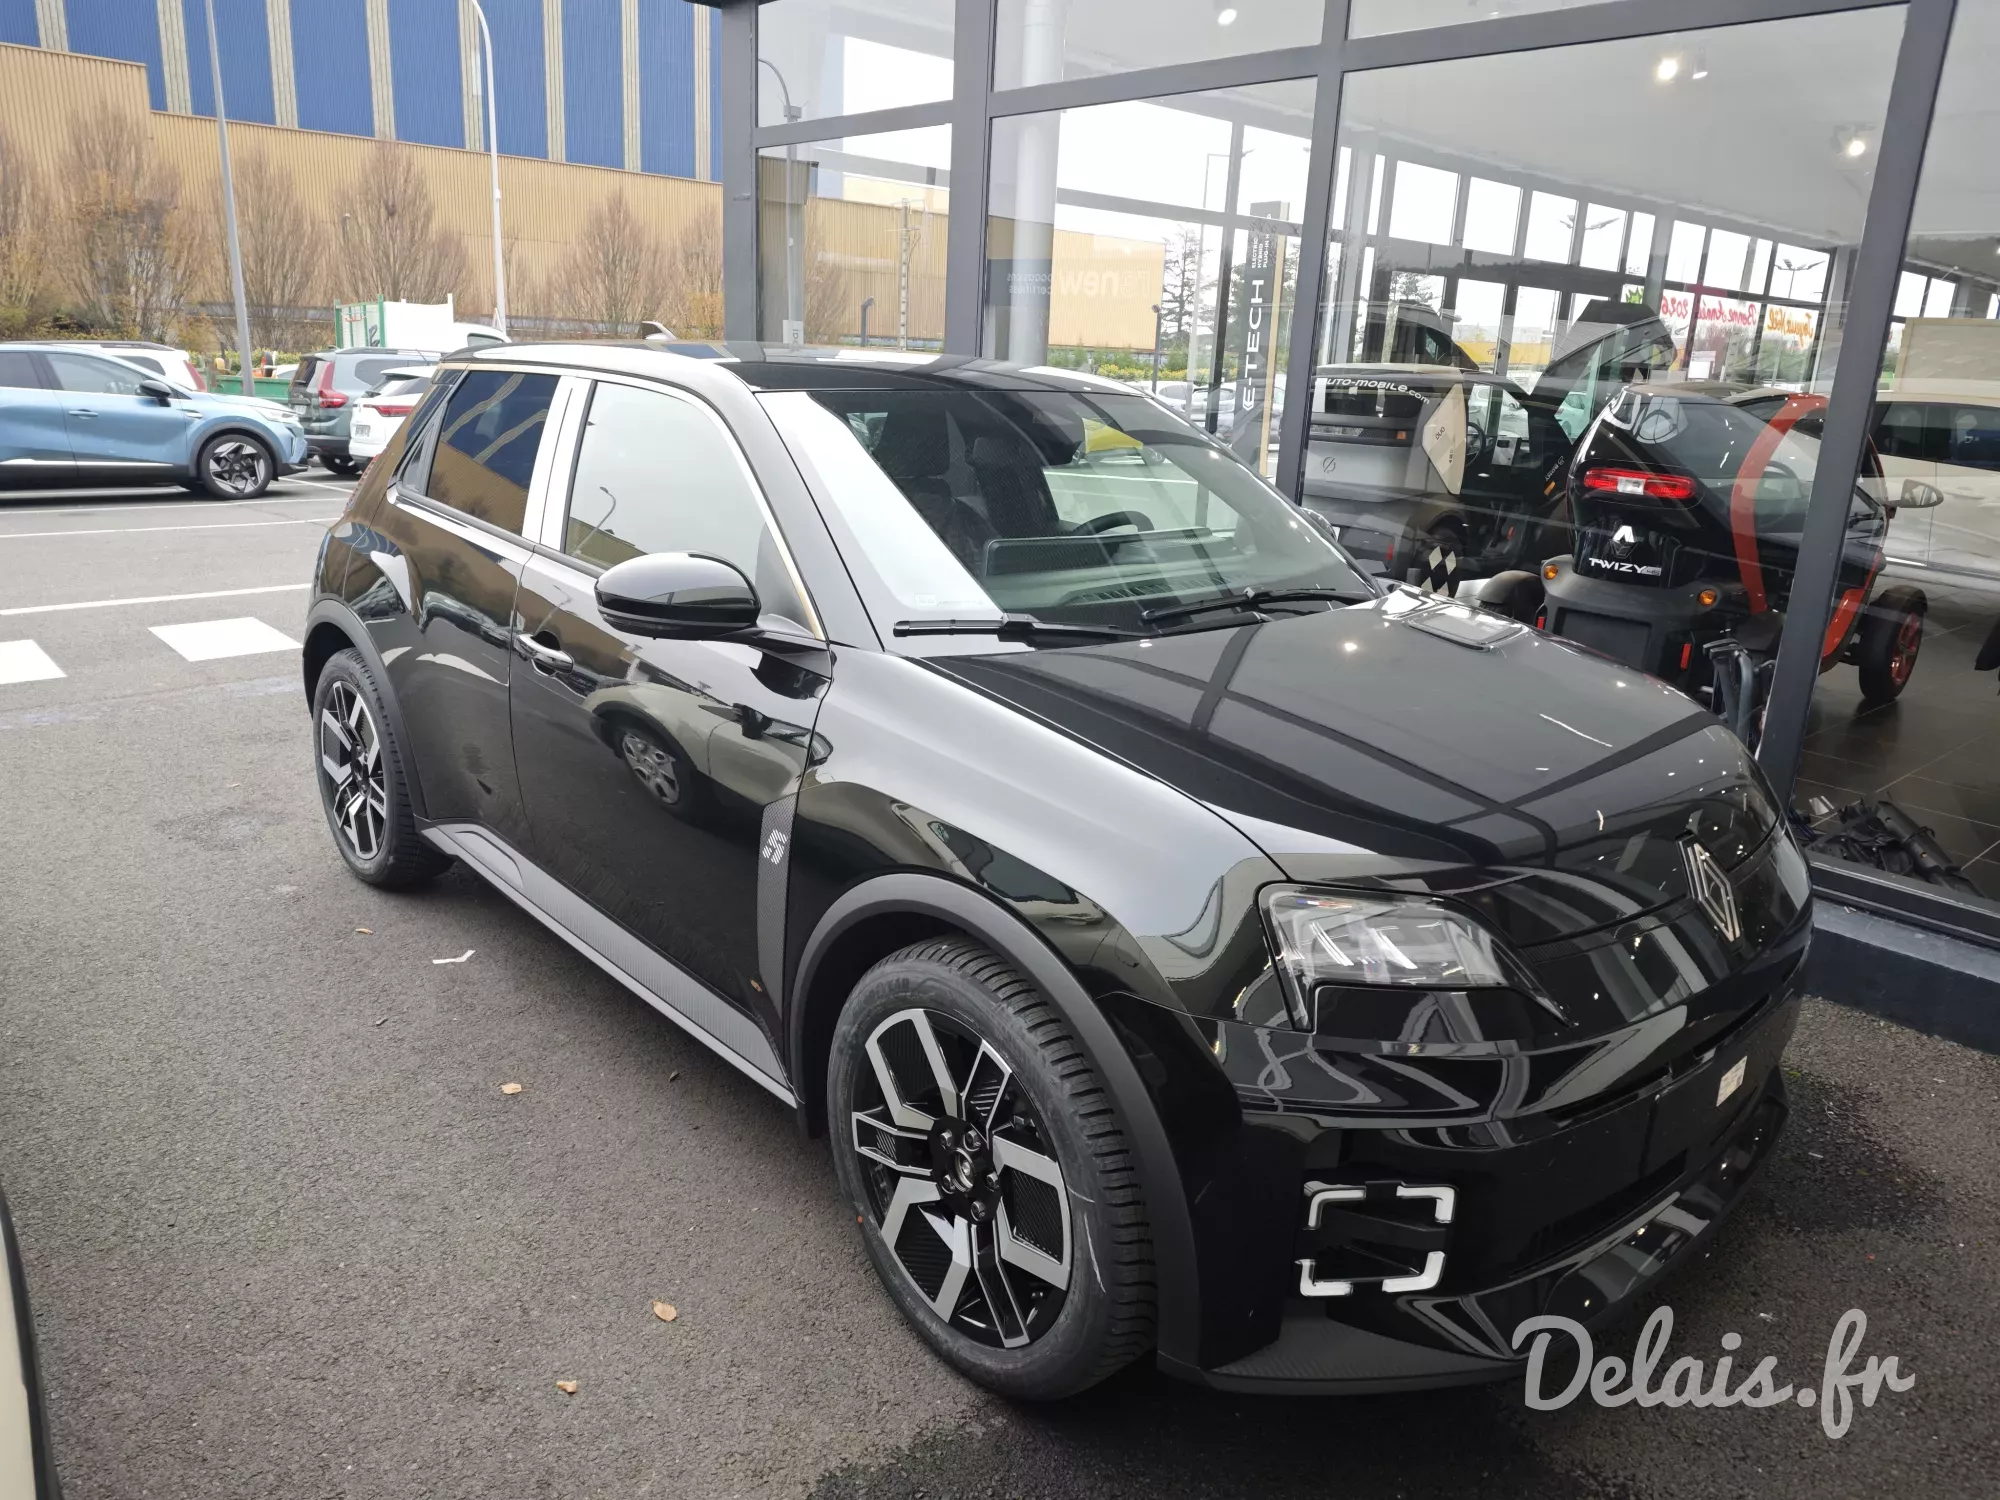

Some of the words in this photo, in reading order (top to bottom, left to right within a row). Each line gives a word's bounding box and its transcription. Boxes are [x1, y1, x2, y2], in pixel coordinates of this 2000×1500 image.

[1242, 279, 1264, 411] E-TECH
[1315, 378, 1430, 404] UTO-MOBILE.com
[1435, 426, 1446, 440] DUO
[1588, 557, 1647, 573] TWIZY
